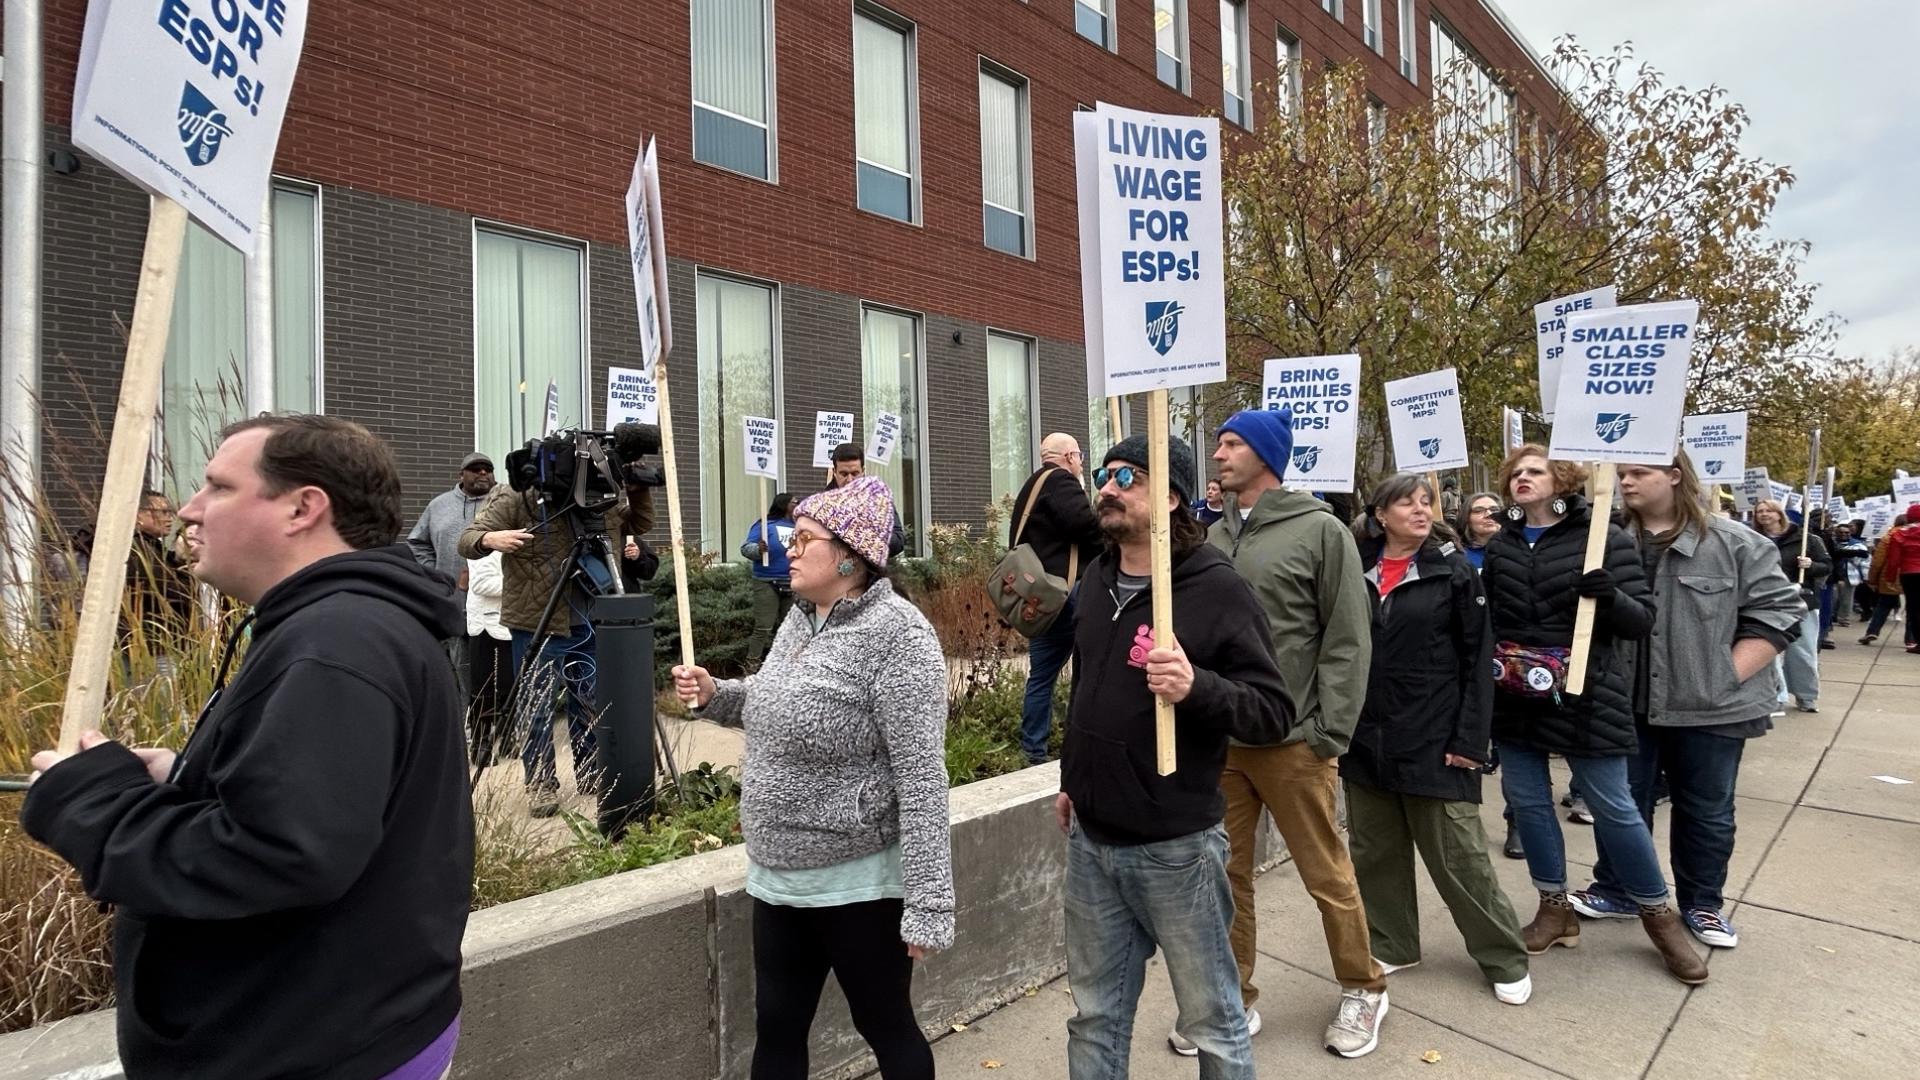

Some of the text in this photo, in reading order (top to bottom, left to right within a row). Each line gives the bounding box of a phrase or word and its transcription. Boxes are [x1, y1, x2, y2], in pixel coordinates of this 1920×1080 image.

[212, 0, 263, 65] OR
[158, 0, 264, 117] ESPs!
[95, 115, 158, 163] INFORMATIONAL
[1108, 118, 1207, 161] LIVING
[1114, 164, 1202, 201] WAGE
[1129, 210, 1189, 241] FOR
[1122, 251, 1199, 282] ESPs!
[1554, 297, 1593, 317] SAFE
[1571, 324, 1689, 343] SMALLER
[1586, 343, 1666, 360] CLASS
[1280, 367, 1340, 384] BRING
[1587, 362, 1657, 377] SIZES
[611, 382, 657, 394] FAMILIES
[1267, 383, 1353, 400] FAMILIES
[1585, 380, 1654, 395] NOW!
[611, 391, 656, 402] BACK TO
[1391, 388, 1455, 407] COMPETITIVE
[620, 401, 646, 410] MPS!
[1320, 399, 1349, 413] TO
[1407, 400, 1439, 412] PAY IN
[1412, 409, 1437, 419] MPS!
[746, 420, 774, 430] LIVING
[818, 420, 852, 428] STAFFING
[748, 428, 773, 438] WAGE
[820, 433, 848, 441] SPECIAL
[753, 437, 770, 446] FOR
[1534, 669, 1551, 684] YES!
